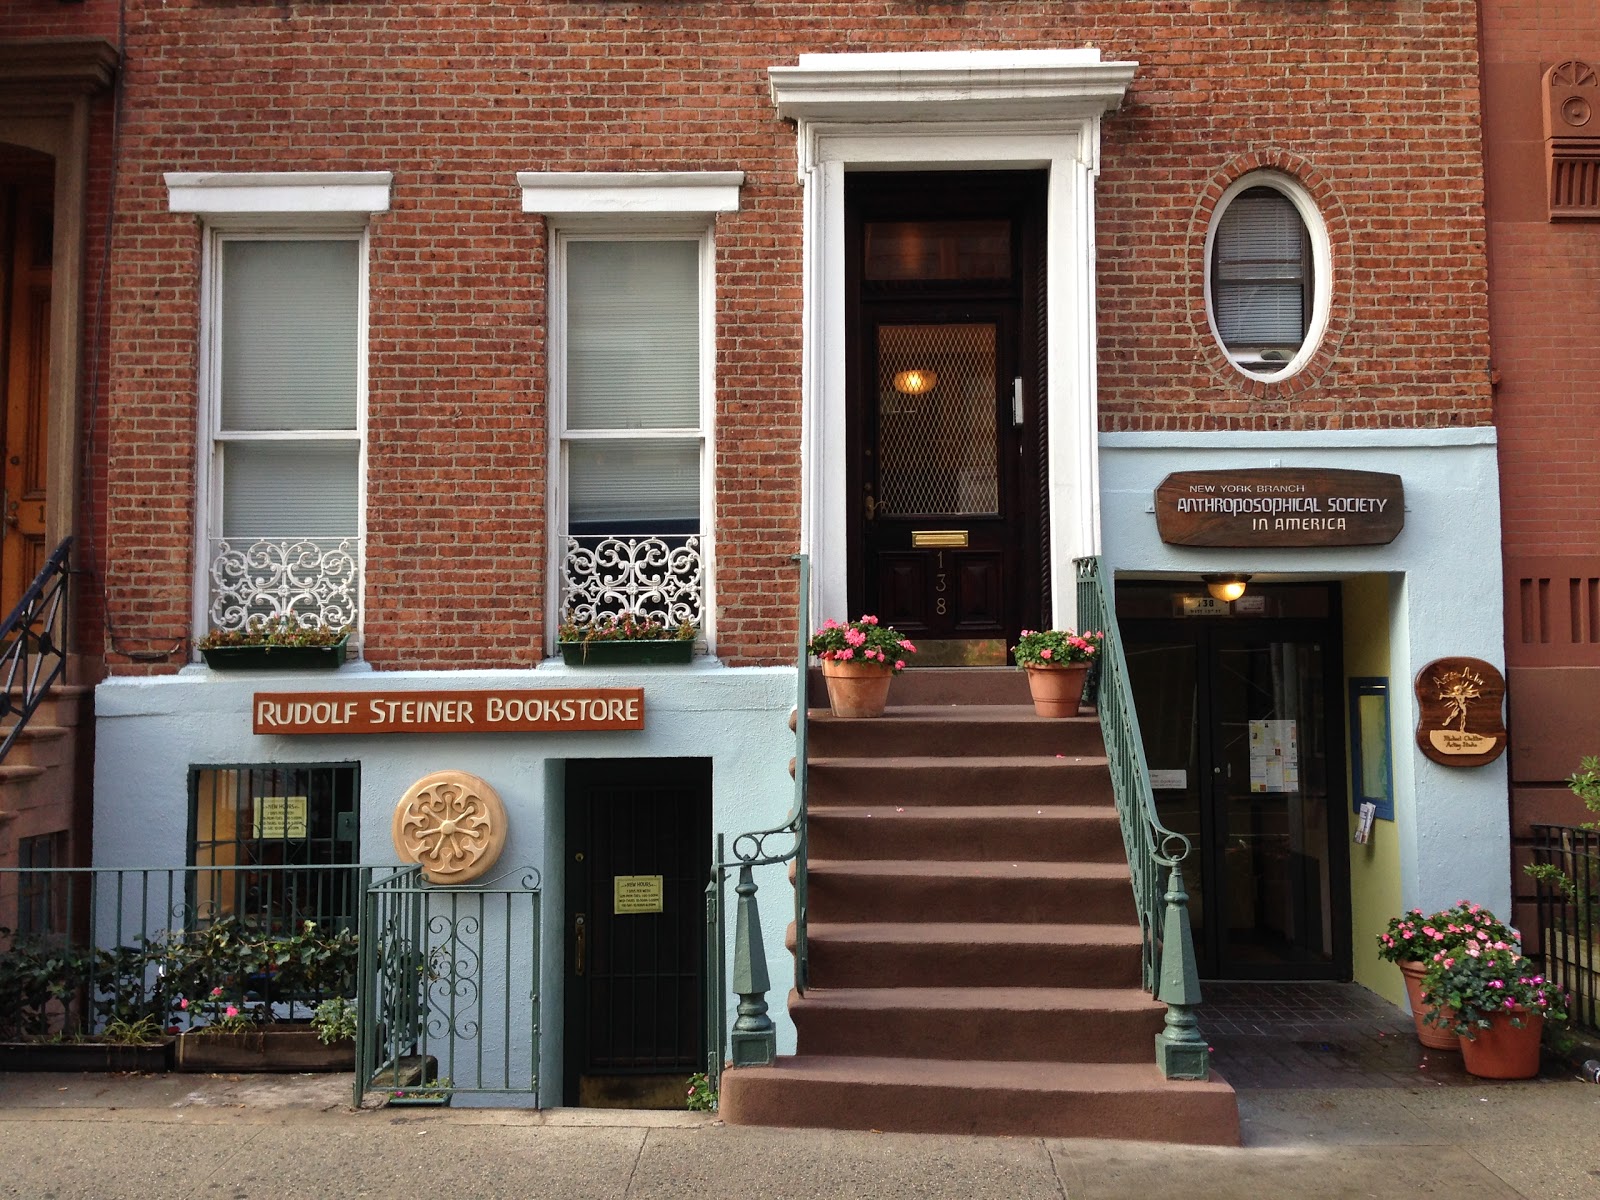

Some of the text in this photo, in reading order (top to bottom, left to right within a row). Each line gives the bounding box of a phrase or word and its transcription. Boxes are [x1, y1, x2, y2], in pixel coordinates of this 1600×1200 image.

[1189, 485, 1216, 493] NEW
[1256, 484, 1305, 492] BRANCH
[1177, 497, 1388, 517] ANTHROPOSOPHICAL SOCIETY
[1252, 517, 1346, 531] IN AMERICA
[257, 697, 639, 726] RUDOLF STEINER BOOKSTORE
